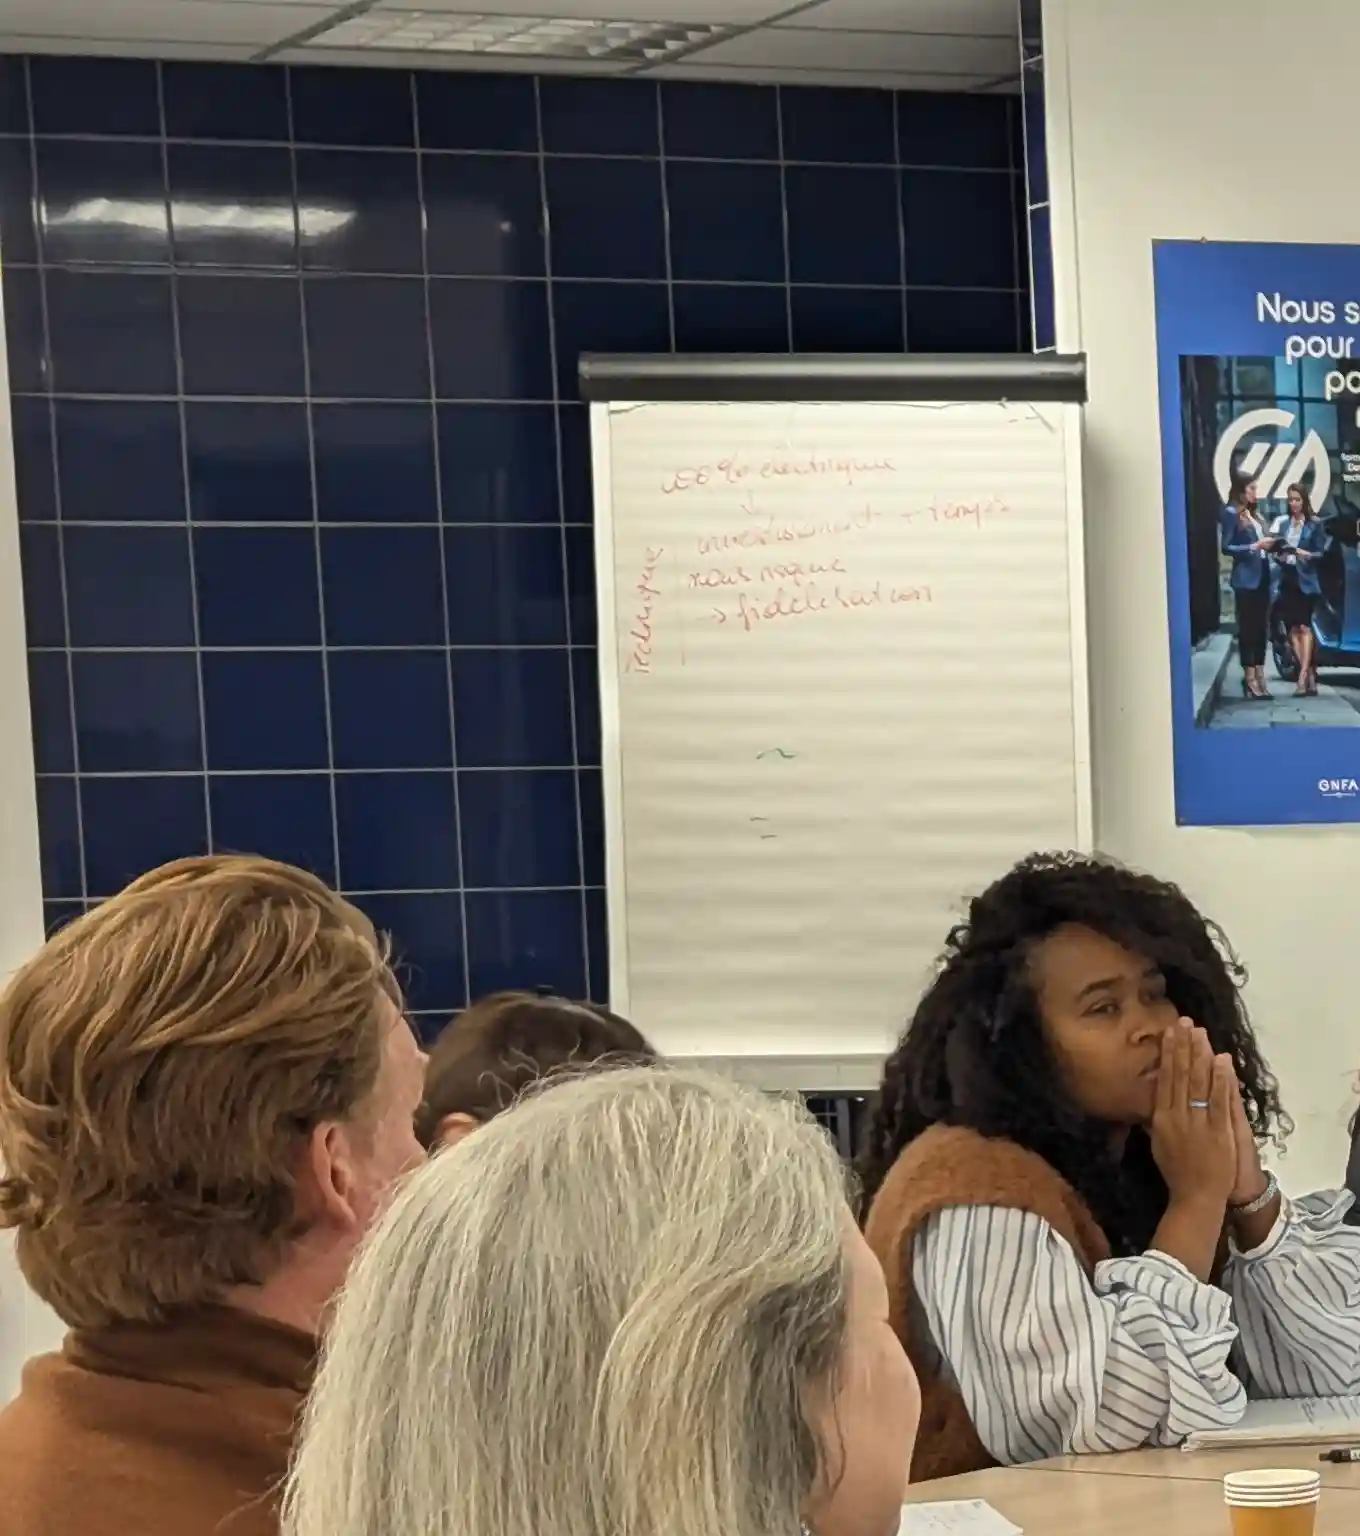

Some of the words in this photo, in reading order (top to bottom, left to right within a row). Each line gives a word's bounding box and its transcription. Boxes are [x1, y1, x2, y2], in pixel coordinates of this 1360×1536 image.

[1256, 291, 1336, 324] Nous
[1285, 334, 1355, 365] pour
[1319, 779, 1360, 791] GNFA
